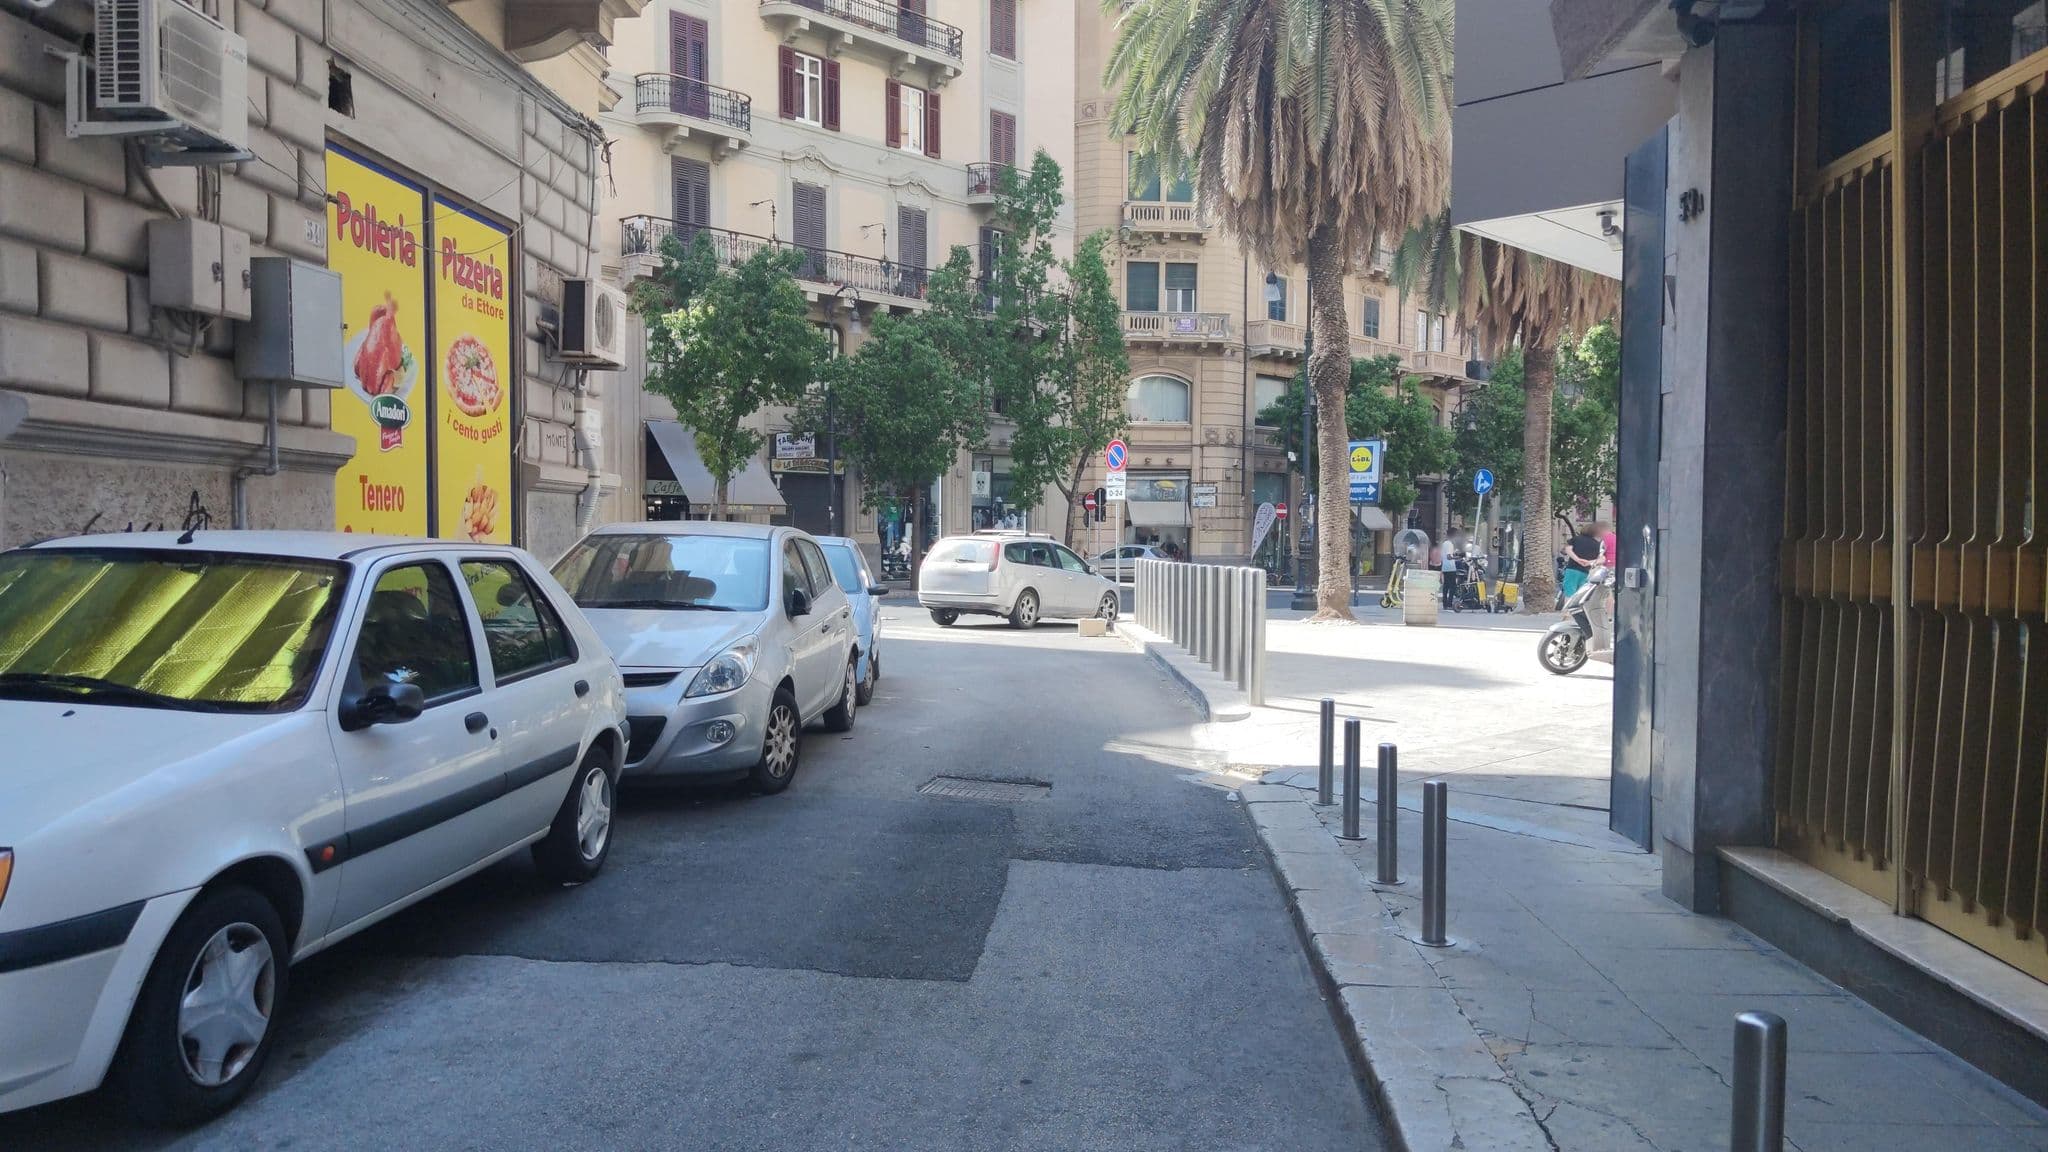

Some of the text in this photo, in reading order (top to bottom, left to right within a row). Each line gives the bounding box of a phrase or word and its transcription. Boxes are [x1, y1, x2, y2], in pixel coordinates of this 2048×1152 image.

[337, 190, 416, 268] Polleria
[442, 236, 503, 300] Pizzeria
[462, 293, 504, 320] da Ettore
[376, 400, 406, 422] Amadori
[452, 419, 479, 441] cento
[481, 416, 503, 445] gusti
[777, 433, 813, 445] TABCHI
[359, 474, 405, 513] Tenero
[1108, 489, 1123, 497] 0-24
